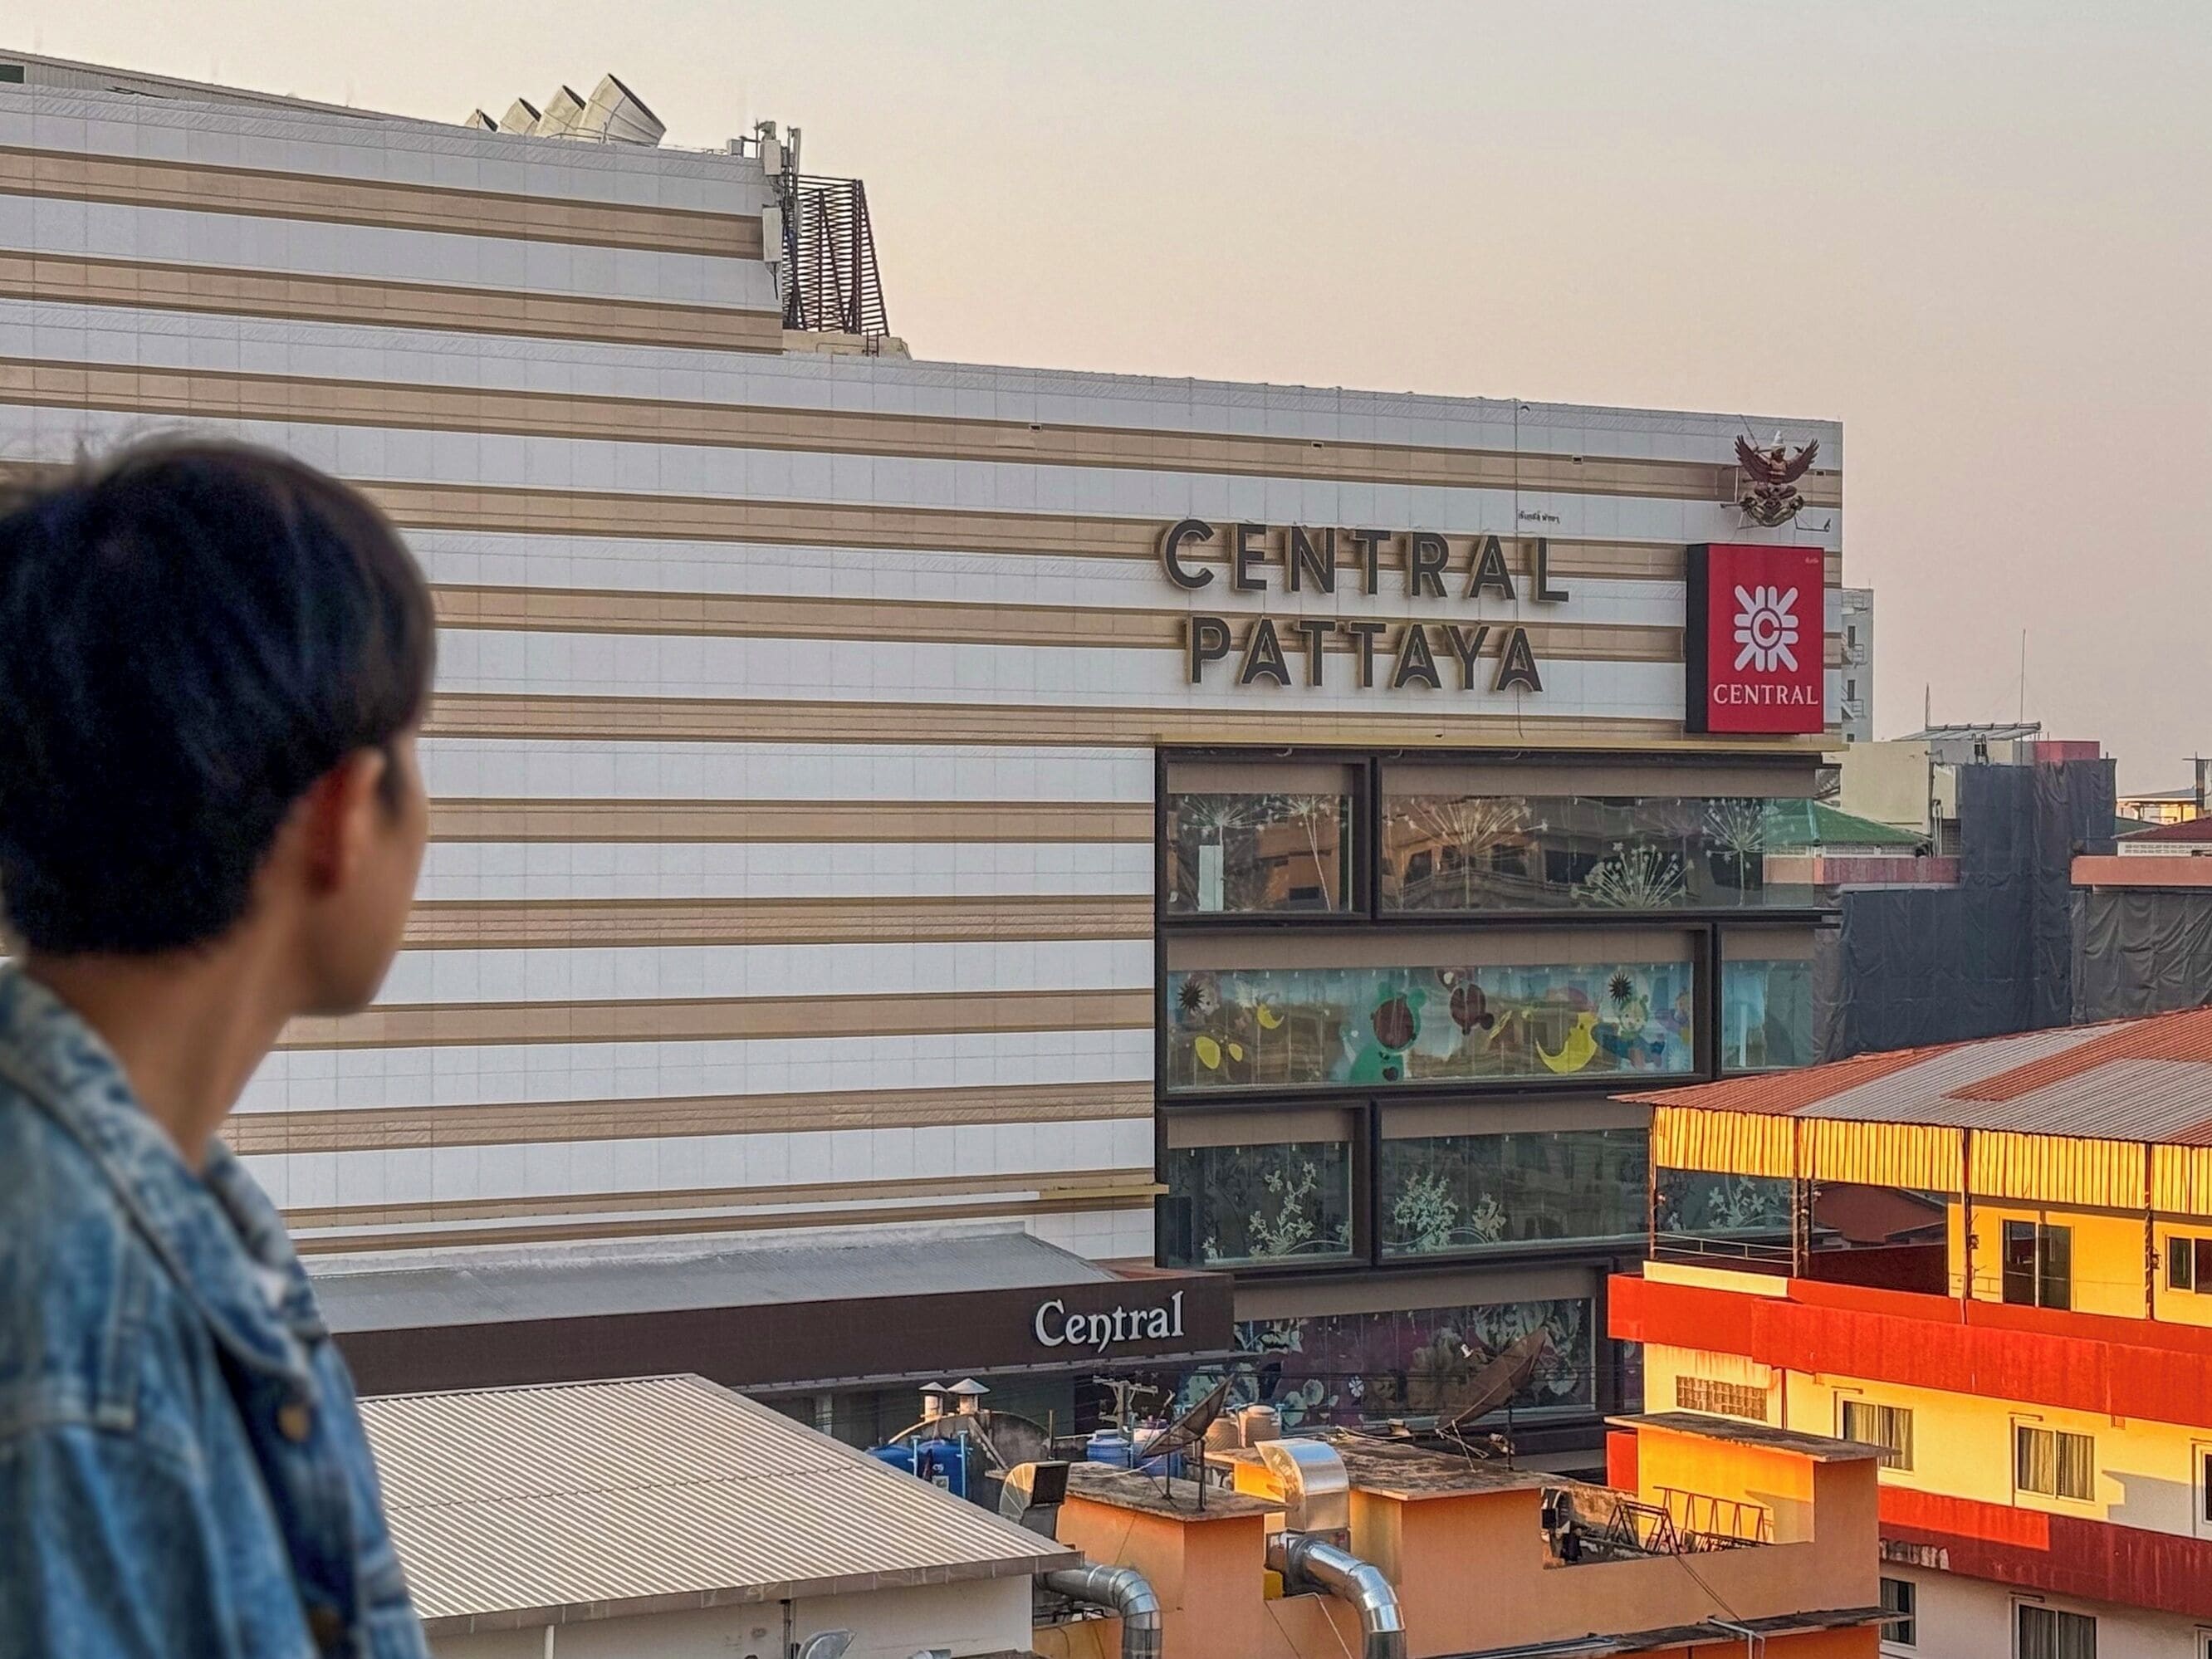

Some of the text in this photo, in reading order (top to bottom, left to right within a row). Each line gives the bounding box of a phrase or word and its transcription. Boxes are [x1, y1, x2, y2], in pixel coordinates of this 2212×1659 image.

[1164, 519, 1570, 602] CENTRAL
[1188, 616, 1544, 692] PATTAYA
[1713, 683, 1818, 705] CENTRAL
[1035, 1290, 1185, 1353] Central
